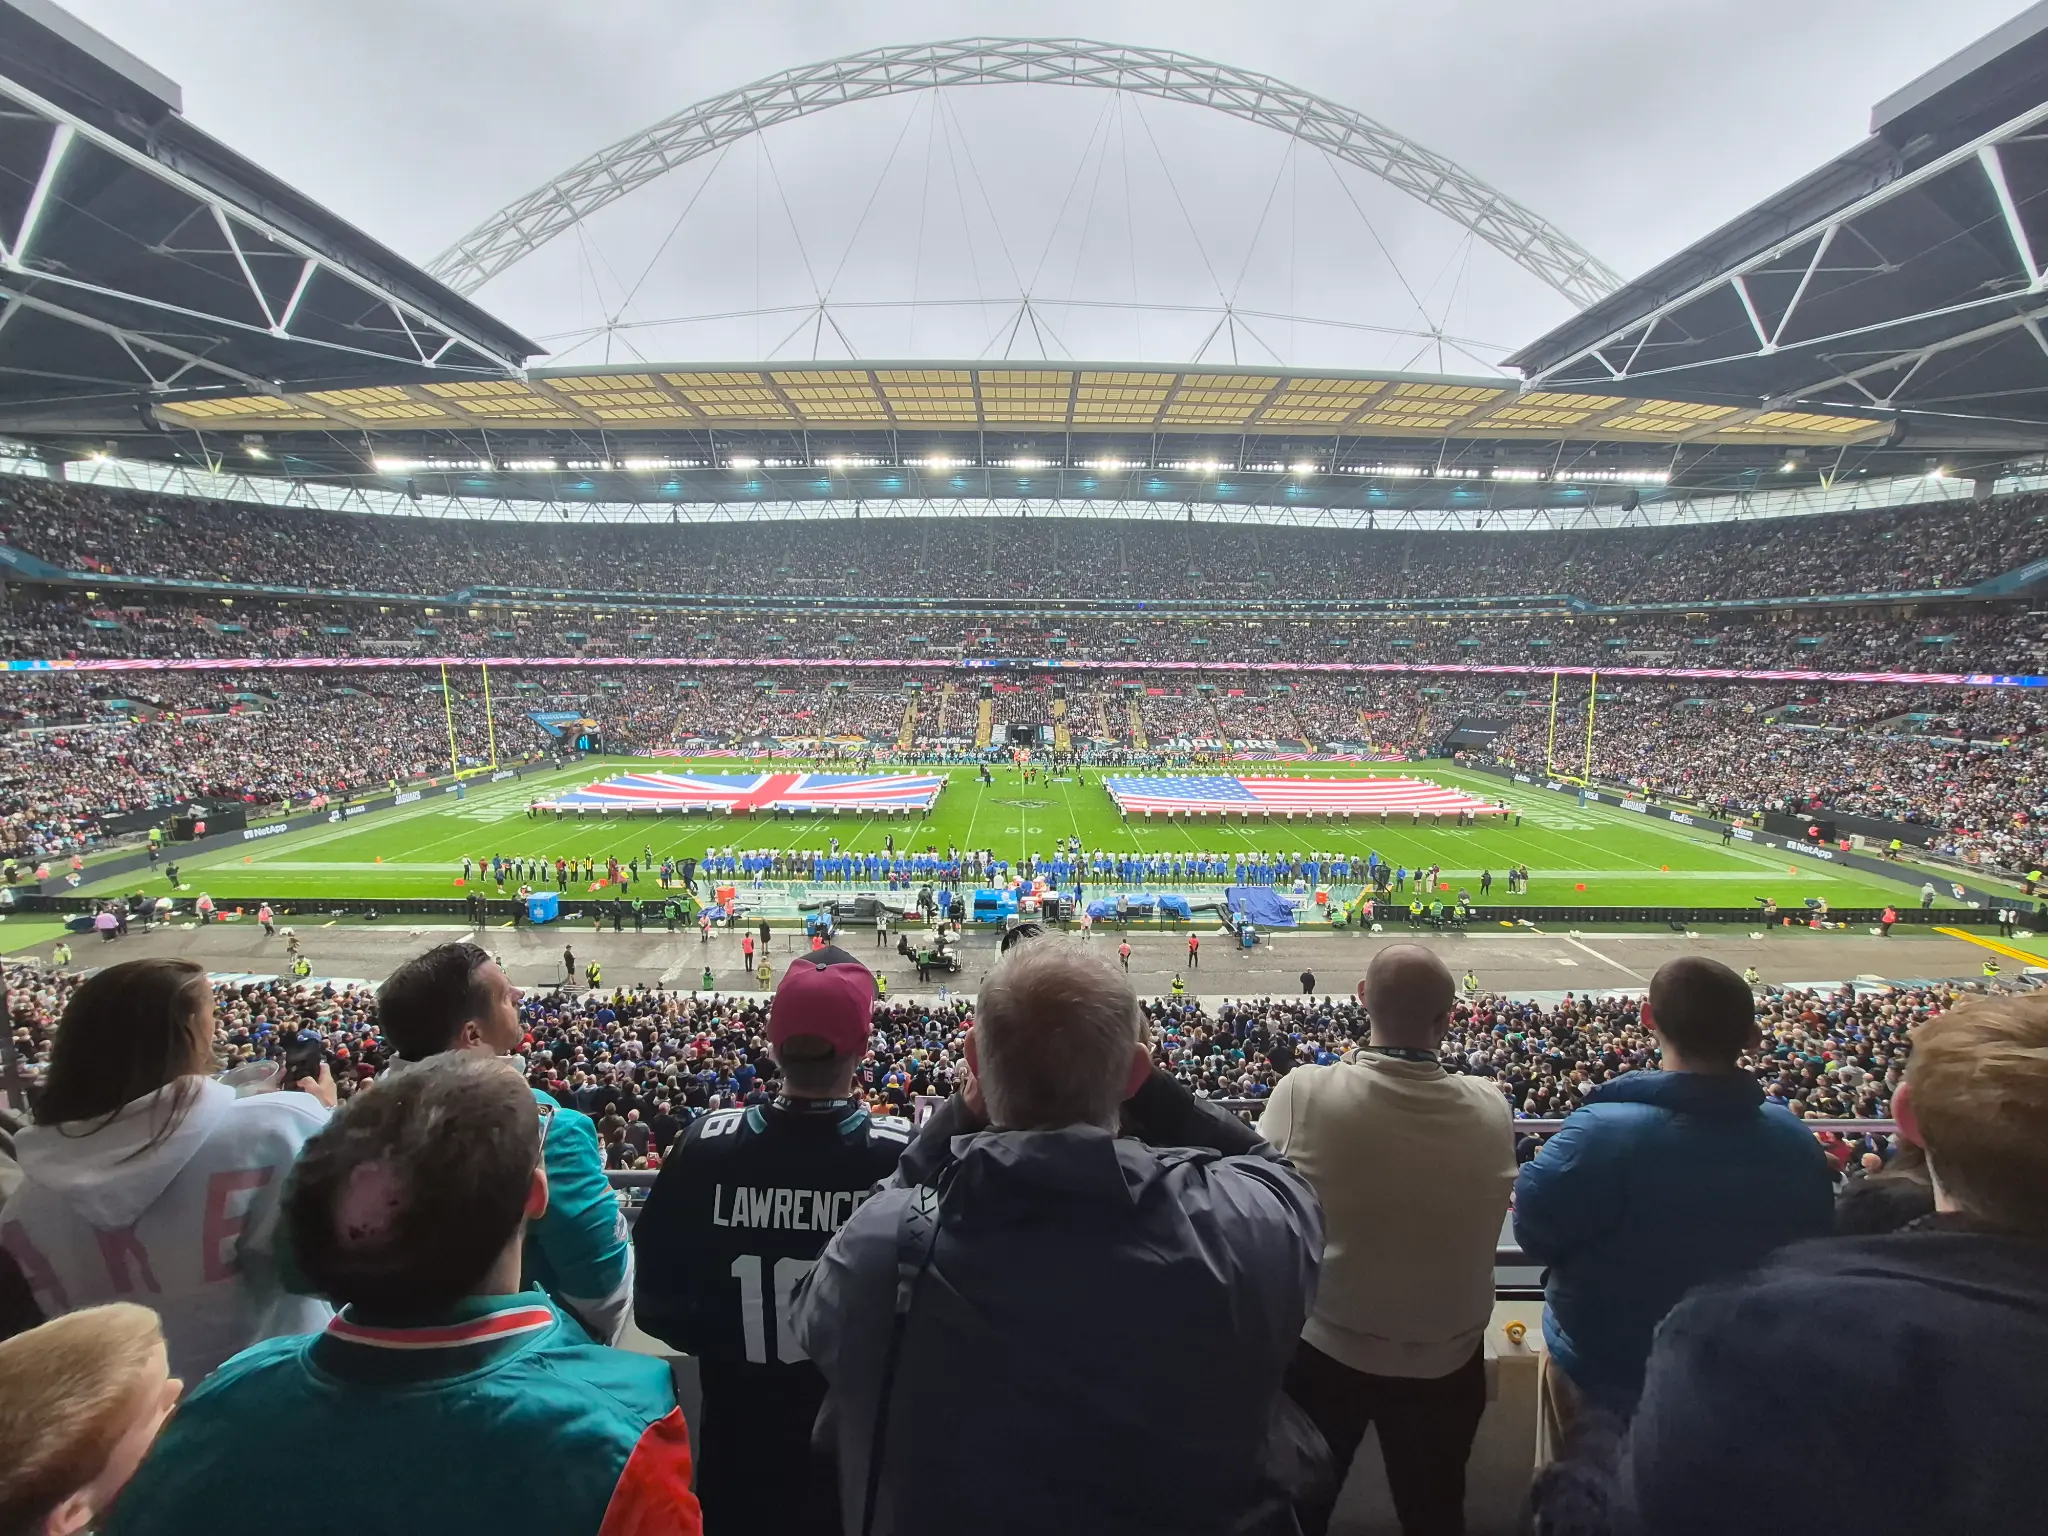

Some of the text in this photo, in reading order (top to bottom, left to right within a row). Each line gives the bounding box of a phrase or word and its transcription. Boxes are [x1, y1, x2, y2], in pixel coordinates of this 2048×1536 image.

[395, 790, 421, 806] JAGUARS
[1584, 790, 1599, 801] VISA
[1620, 798, 1647, 814] JAGUARS
[1669, 811, 1693, 825] FedEx
[253, 823, 288, 837] NetApp
[1796, 842, 1832, 859] NetApp
